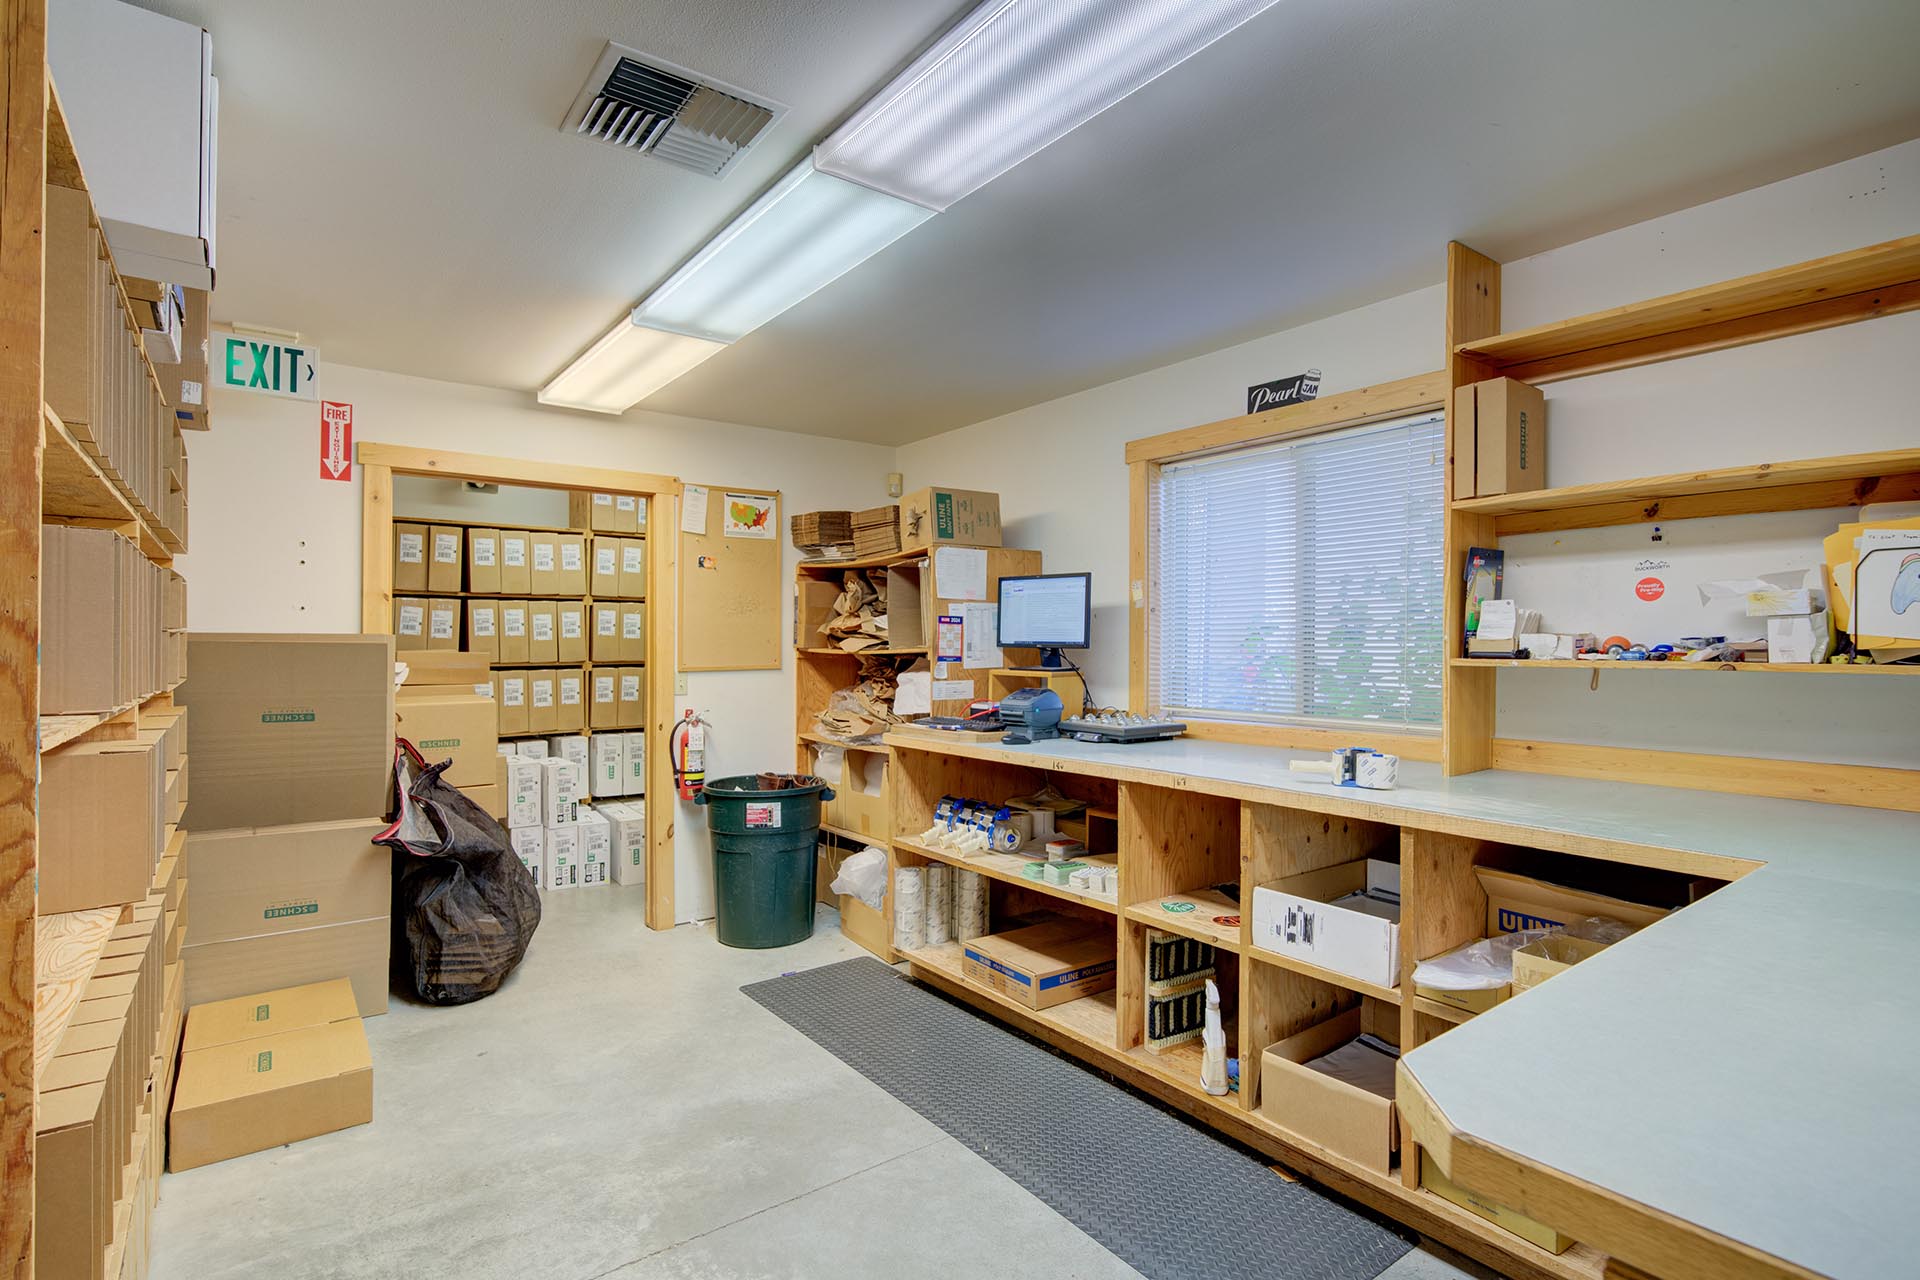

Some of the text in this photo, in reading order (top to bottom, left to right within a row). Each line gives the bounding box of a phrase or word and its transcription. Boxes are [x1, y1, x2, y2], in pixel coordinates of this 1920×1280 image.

[226, 338, 304, 393] EXIT
[1303, 384, 1319, 394] JAM
[1251, 380, 1300, 414] Pearl
[326, 407, 348, 421] FIRE
[938, 503, 947, 529] ULINE
[266, 905, 309, 918] SCHNEE
[1059, 971, 1080, 984] ULINE
